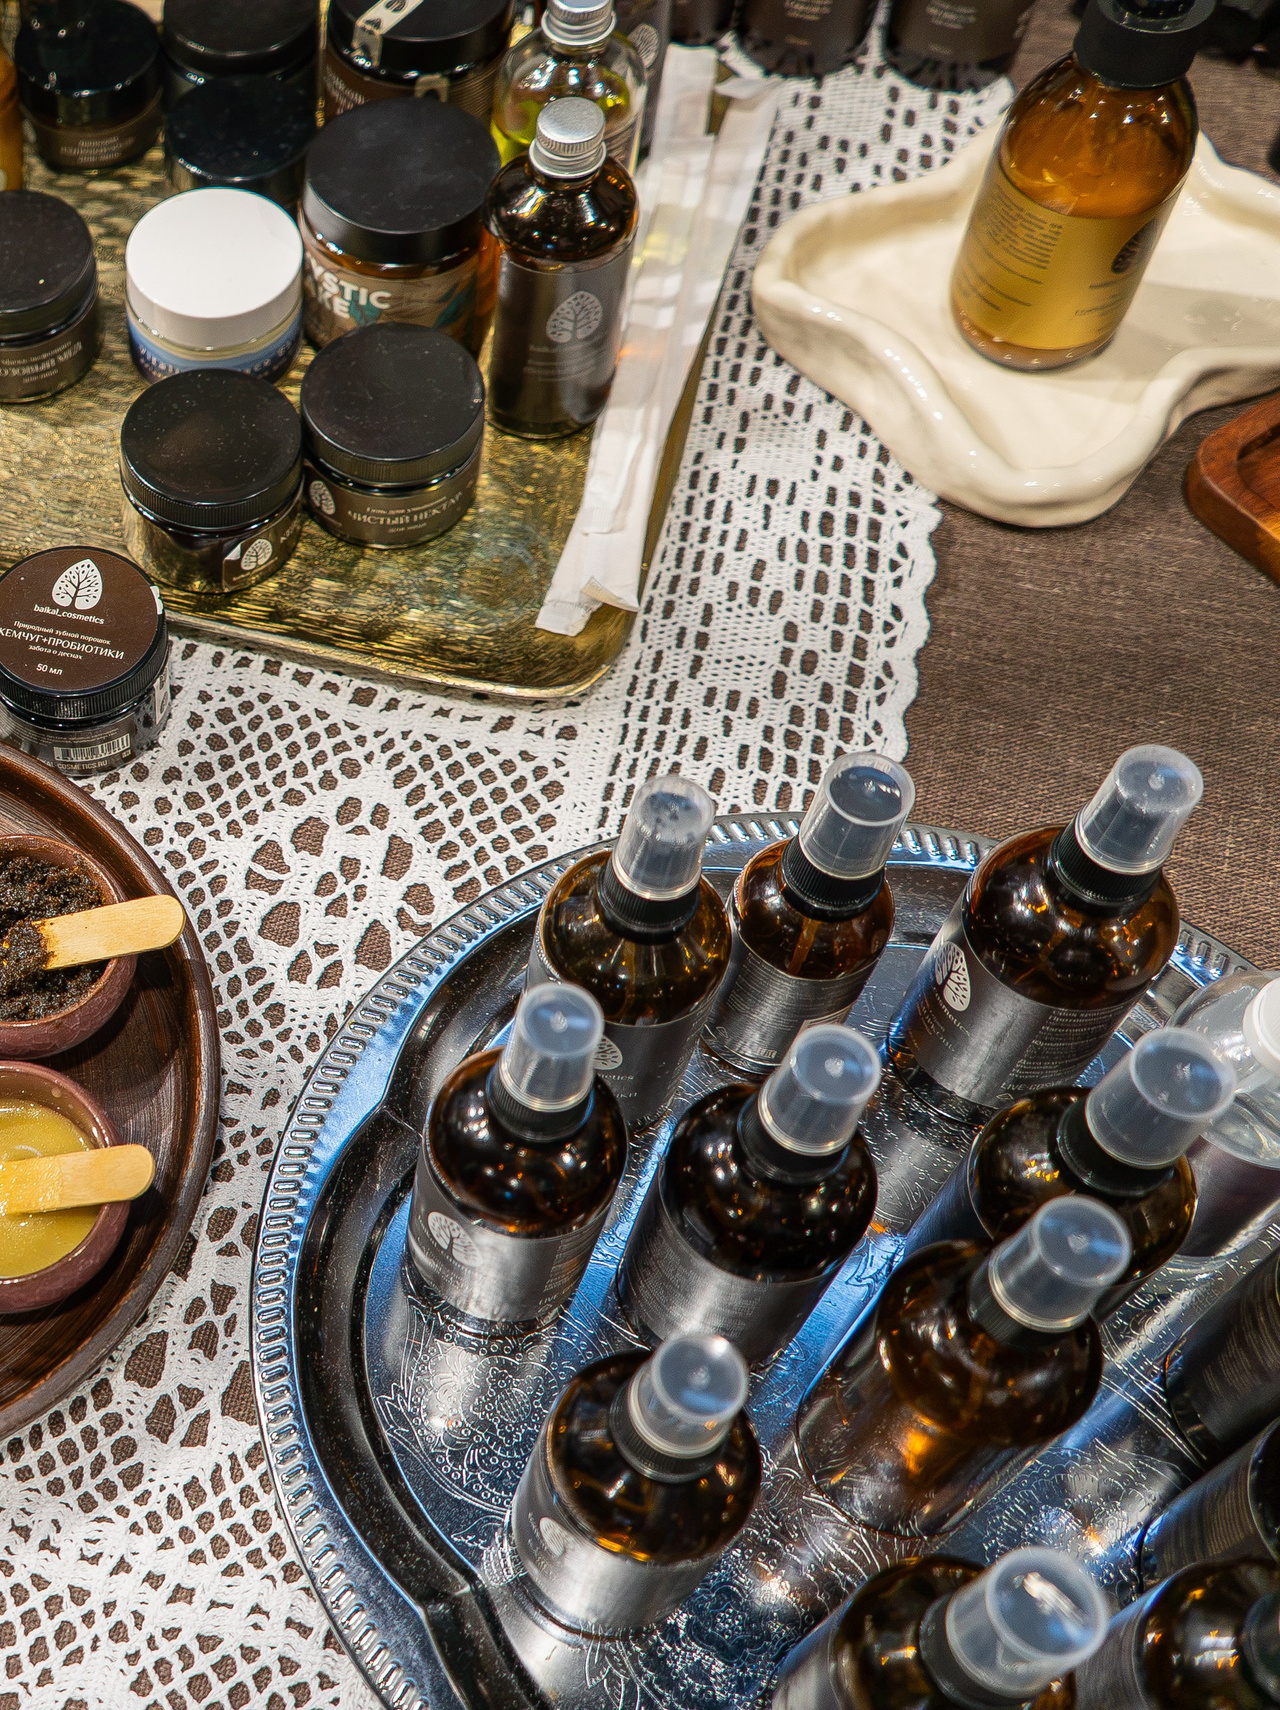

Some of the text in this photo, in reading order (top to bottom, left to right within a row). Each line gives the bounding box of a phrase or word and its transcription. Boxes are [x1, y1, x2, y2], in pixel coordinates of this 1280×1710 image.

[306, 252, 392, 310] YSTIC
[33, 604, 105, 625] baikal_cosmetics
[14, 621, 111, 646] Природный зубной порошок
[28, 644, 52, 654] забота
[57, 650, 83, 660] деснах
[36, 663, 63, 676] 50 мл
